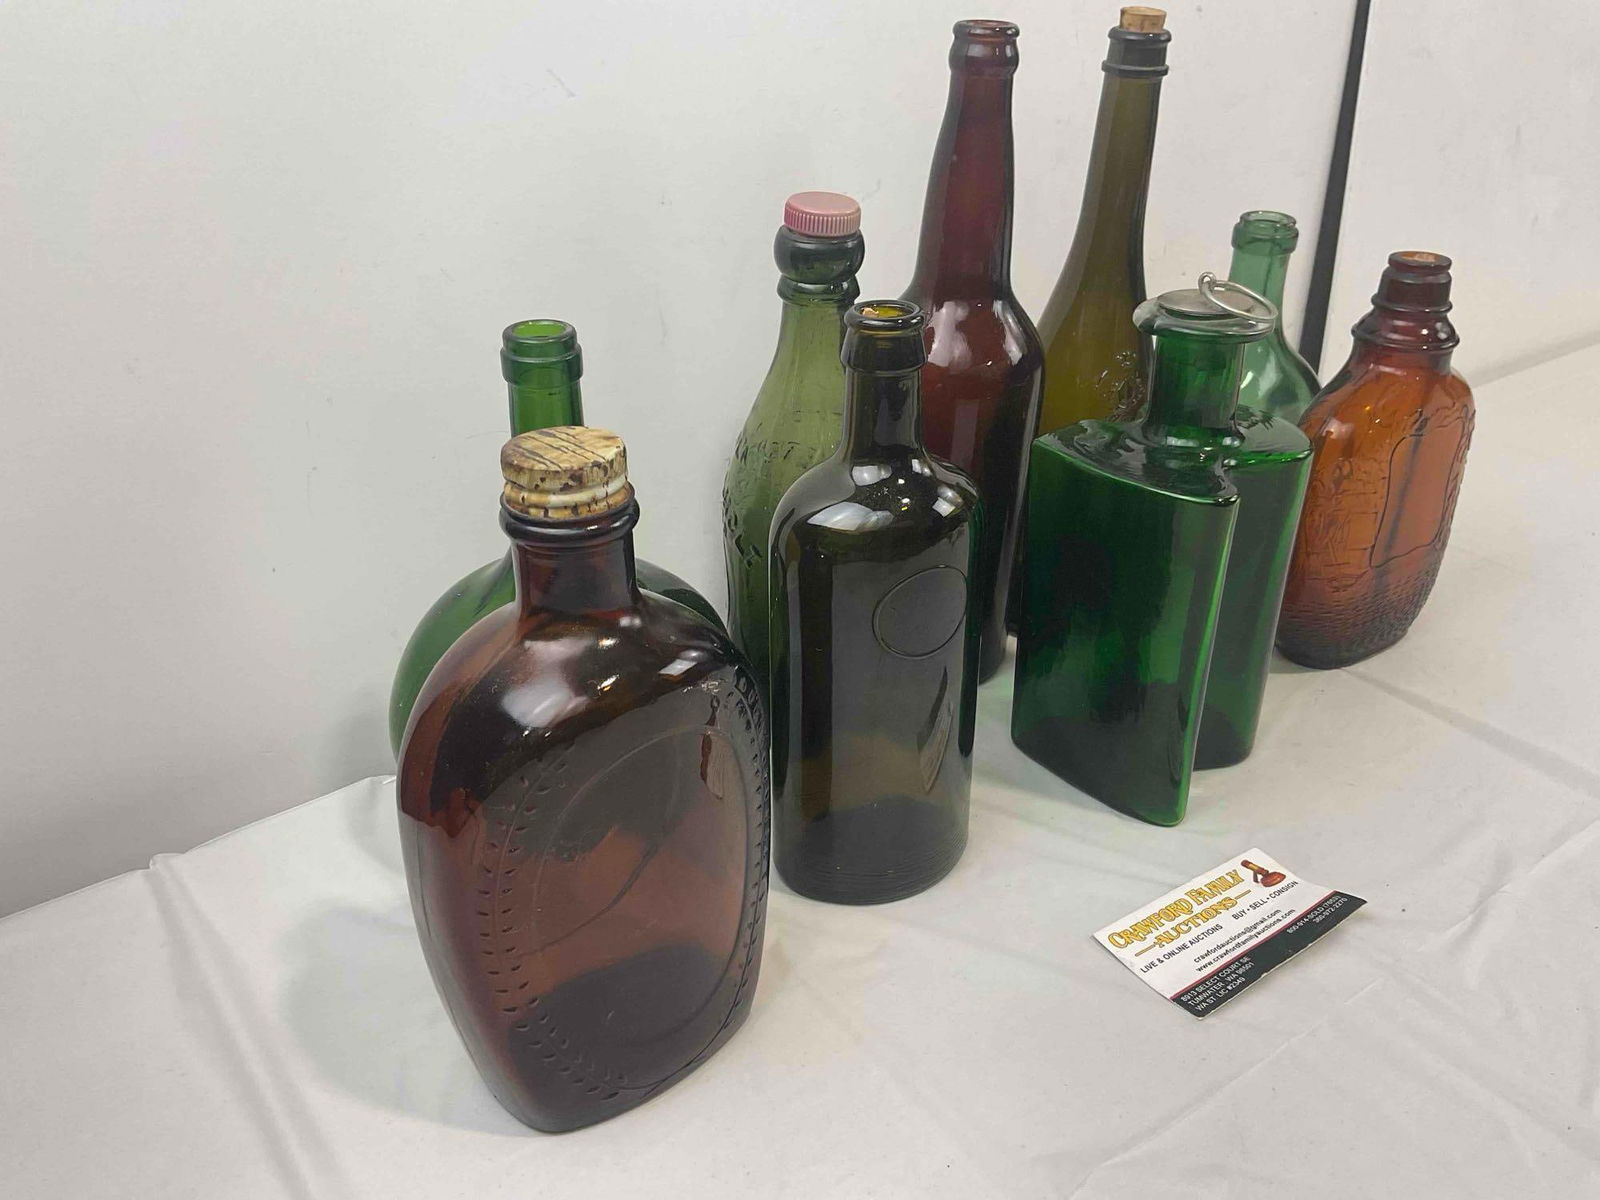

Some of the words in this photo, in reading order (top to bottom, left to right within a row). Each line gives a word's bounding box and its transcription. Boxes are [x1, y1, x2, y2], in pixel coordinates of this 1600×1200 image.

[1108, 898, 1194, 948] CRAWFORD
[1185, 869, 1245, 906] FAMILY
[1155, 897, 1238, 948] AUCTIONS
[1232, 908, 1247, 920] BUY
[1249, 898, 1268, 910] SELL
[1269, 880, 1299, 899] CONSIGN
[1140, 960, 1158, 973] LIVE
[1156, 956, 1164, 964] &
[1163, 942, 1190, 960] ONLINE
[1189, 923, 1223, 946] AUCTIONS
[1194, 909, 1282, 963] crawfordauctions@gmail.com
[1195, 909, 1296, 972] www.crawfordfamilyauctions.com
[1195, 975, 1220, 992] SELECT
[1219, 961, 1241, 977] COURT
[1195, 1001, 1209, 1012] WA
[1206, 995, 1217, 1004] ST
[1215, 988, 1229, 998] LIC
[1224, 973, 1239, 982] WA
